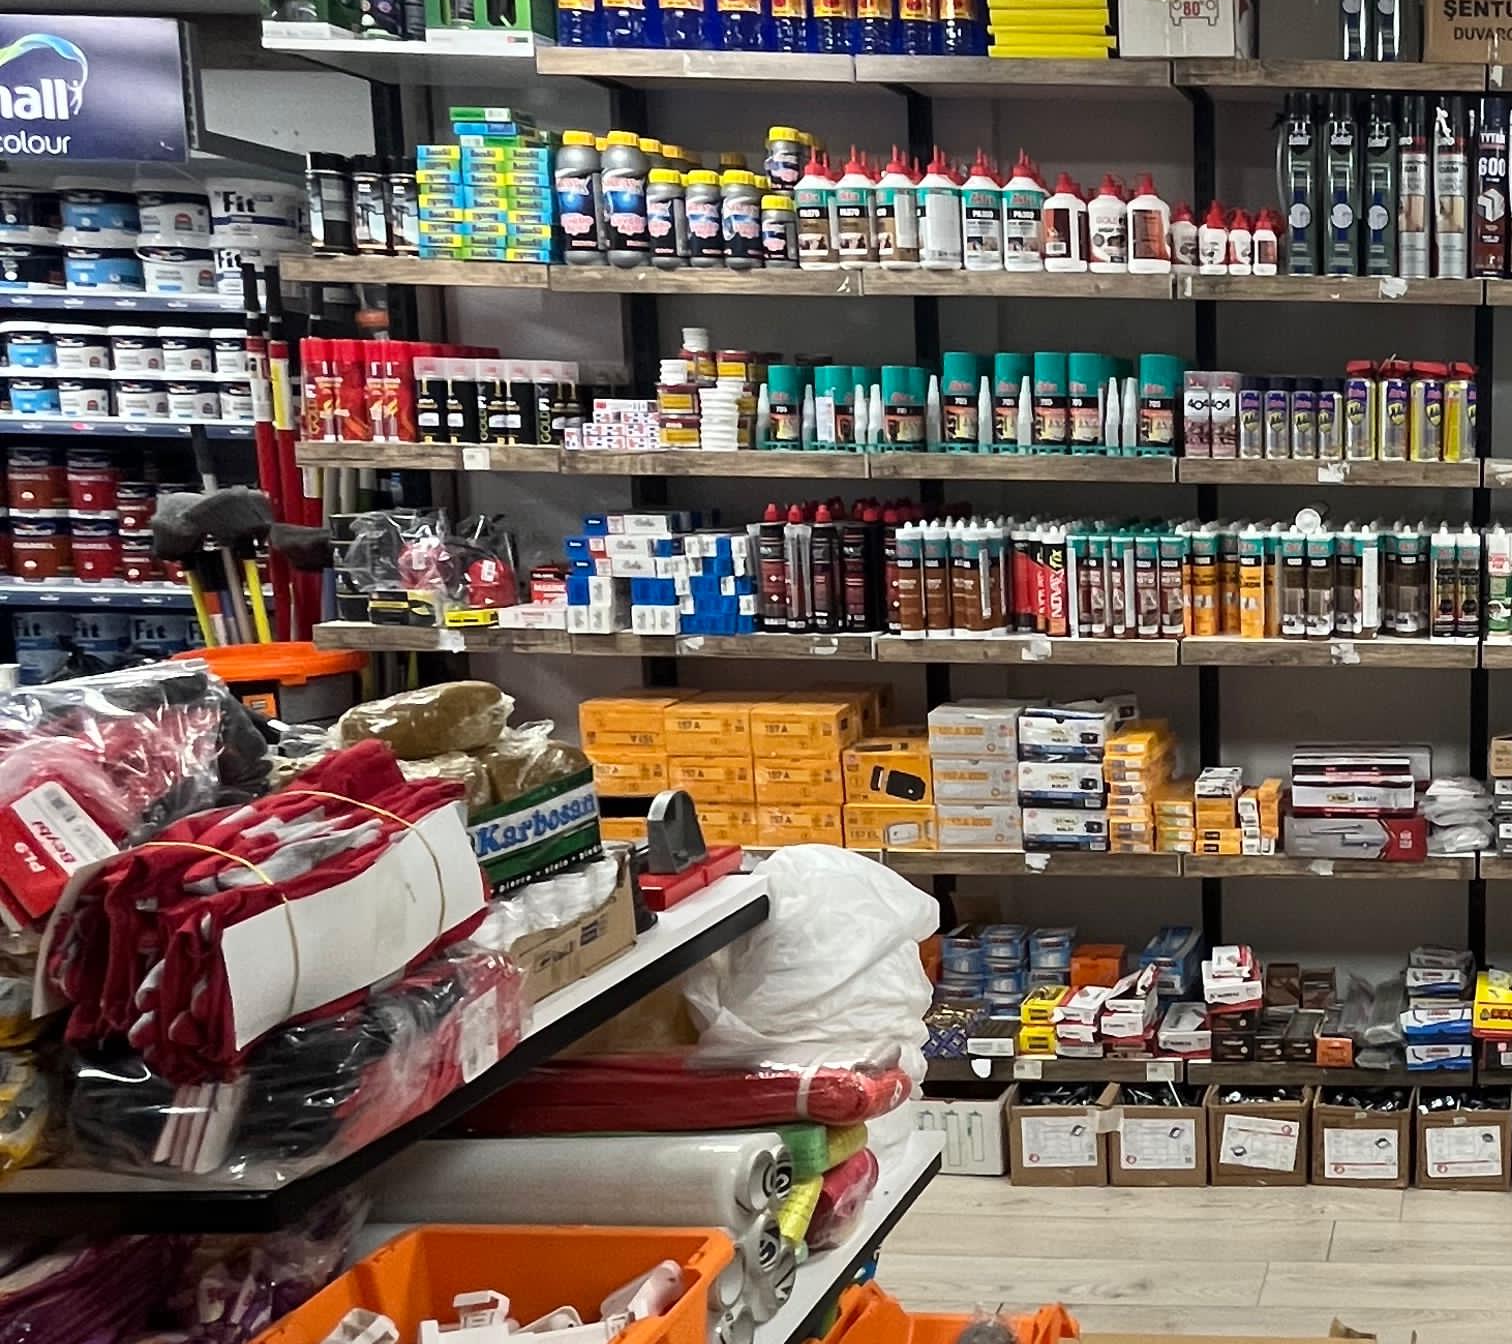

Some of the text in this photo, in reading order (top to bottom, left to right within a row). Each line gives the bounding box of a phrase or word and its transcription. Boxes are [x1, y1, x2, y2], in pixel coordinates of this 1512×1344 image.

[0, 79, 70, 120] all
[1479, 157, 1506, 177] 600
[223, 190, 256, 214] Fit
[475, 793, 596, 856] Karbosan
